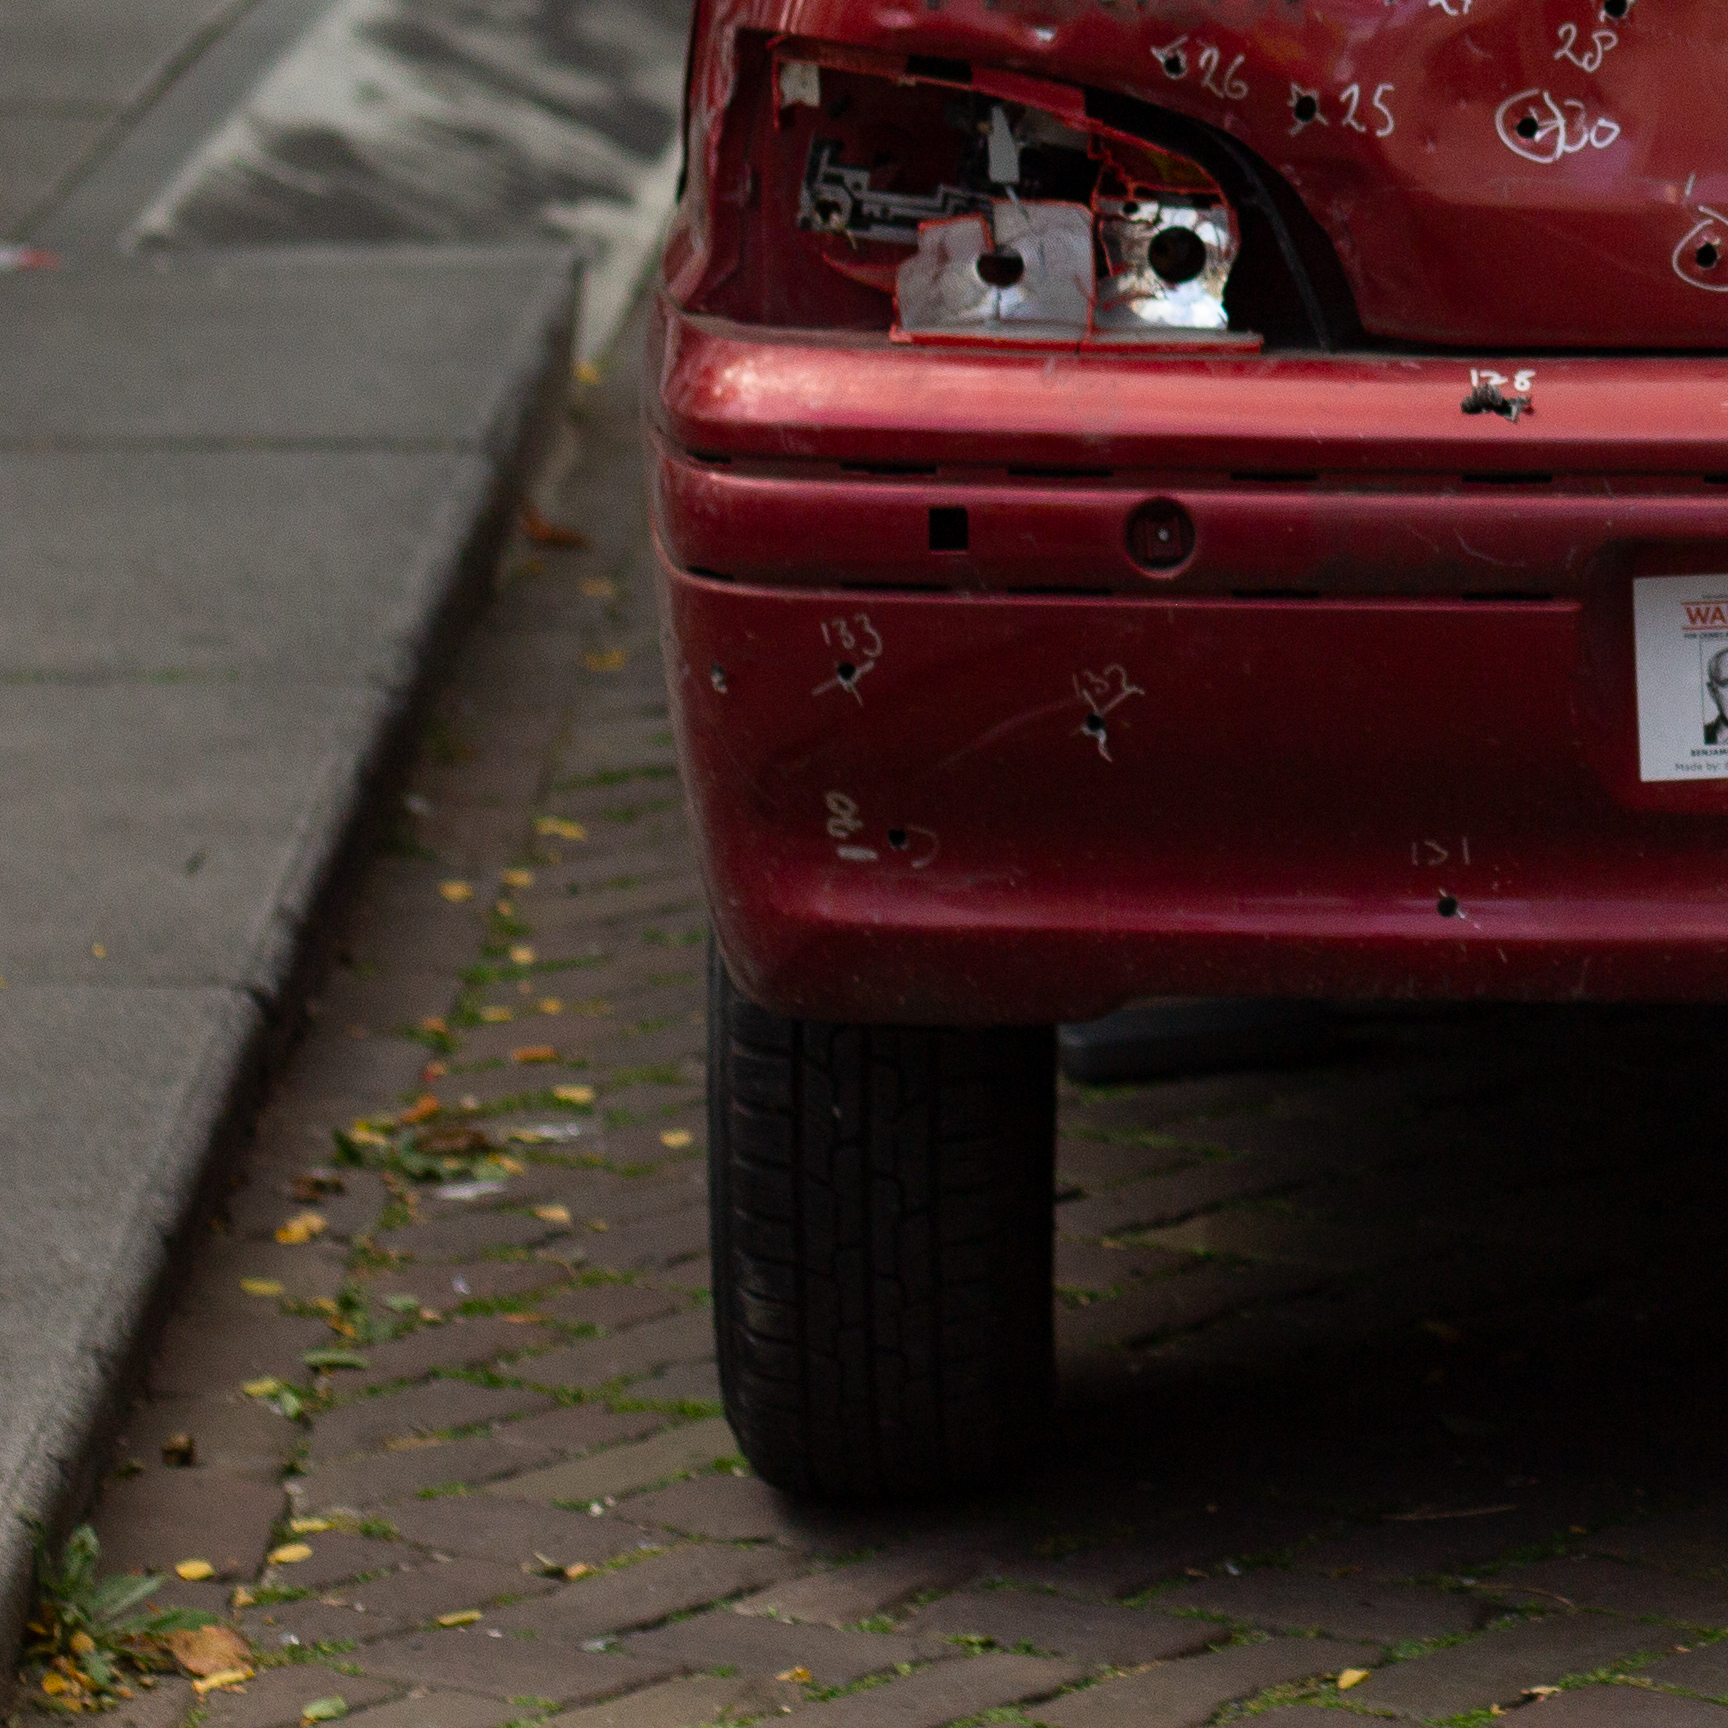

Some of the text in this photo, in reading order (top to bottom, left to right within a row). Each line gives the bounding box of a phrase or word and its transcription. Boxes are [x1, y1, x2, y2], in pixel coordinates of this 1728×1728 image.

[1198, 43, 1249, 99] 26
[1553, 23, 1618, 72] 28
[1339, 83, 1394, 137] 25
[1562, 100, 1621, 154] 30
[1468, 367, 1536, 394] 128
[820, 613, 884, 658] 133
[1072, 663, 1135, 700] 132
